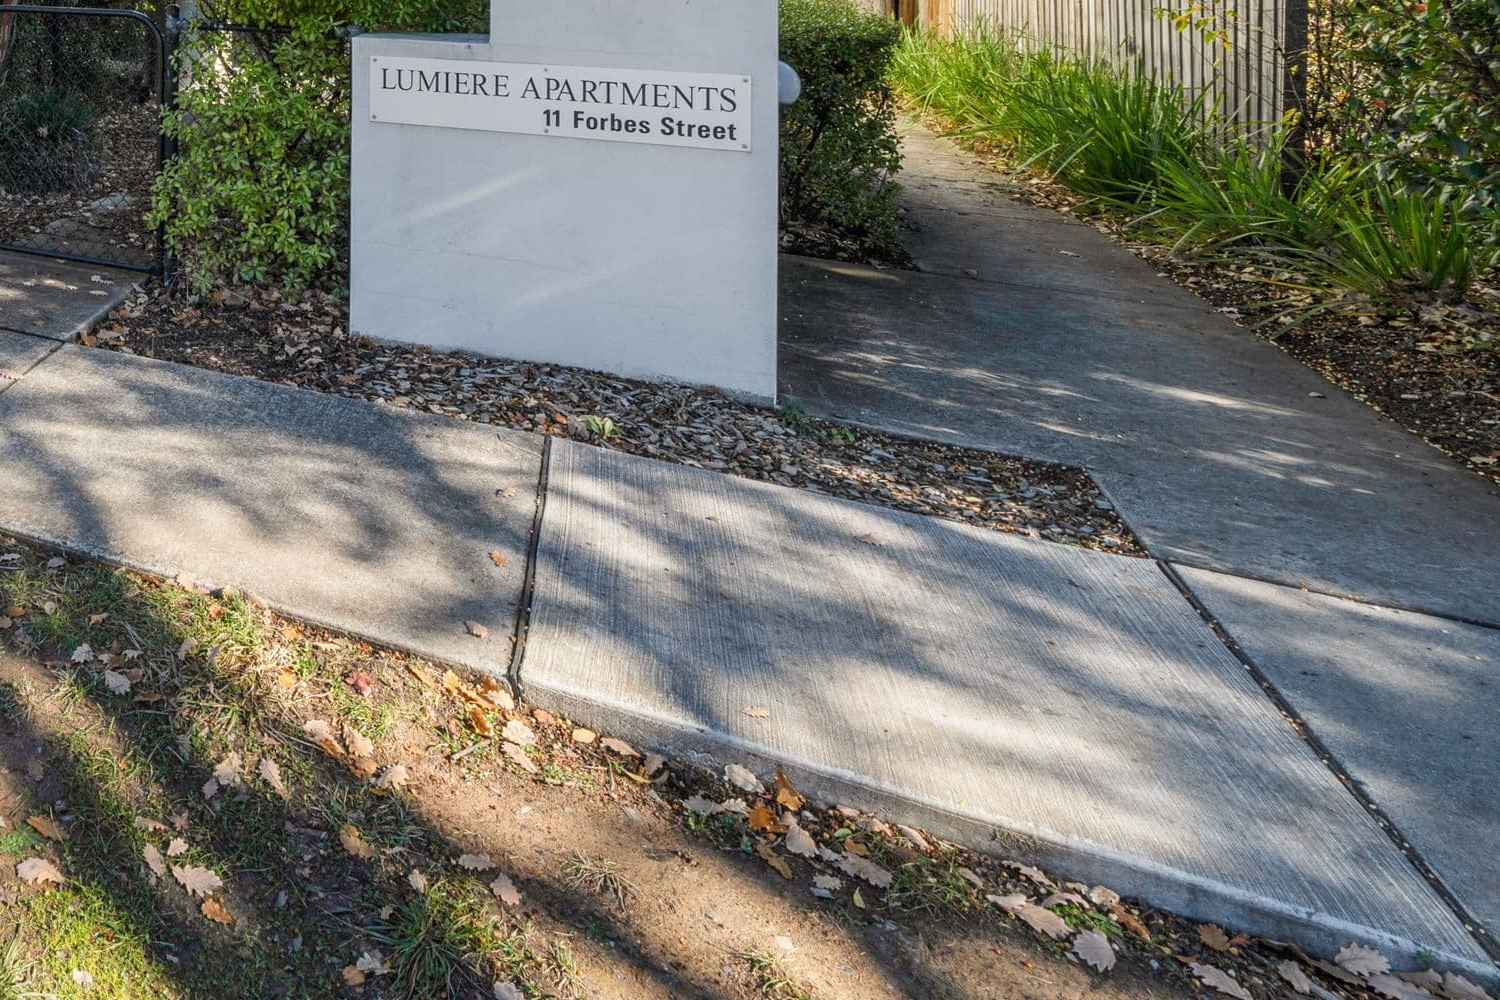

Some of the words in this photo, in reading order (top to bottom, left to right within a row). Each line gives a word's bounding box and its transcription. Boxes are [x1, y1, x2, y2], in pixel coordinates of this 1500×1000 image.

[382, 68, 510, 98] LUMIERE
[520, 76, 738, 113] APARTMENTS
[542, 109, 561, 128] 11
[573, 110, 651, 135] Forbes
[660, 116, 738, 141] Street
